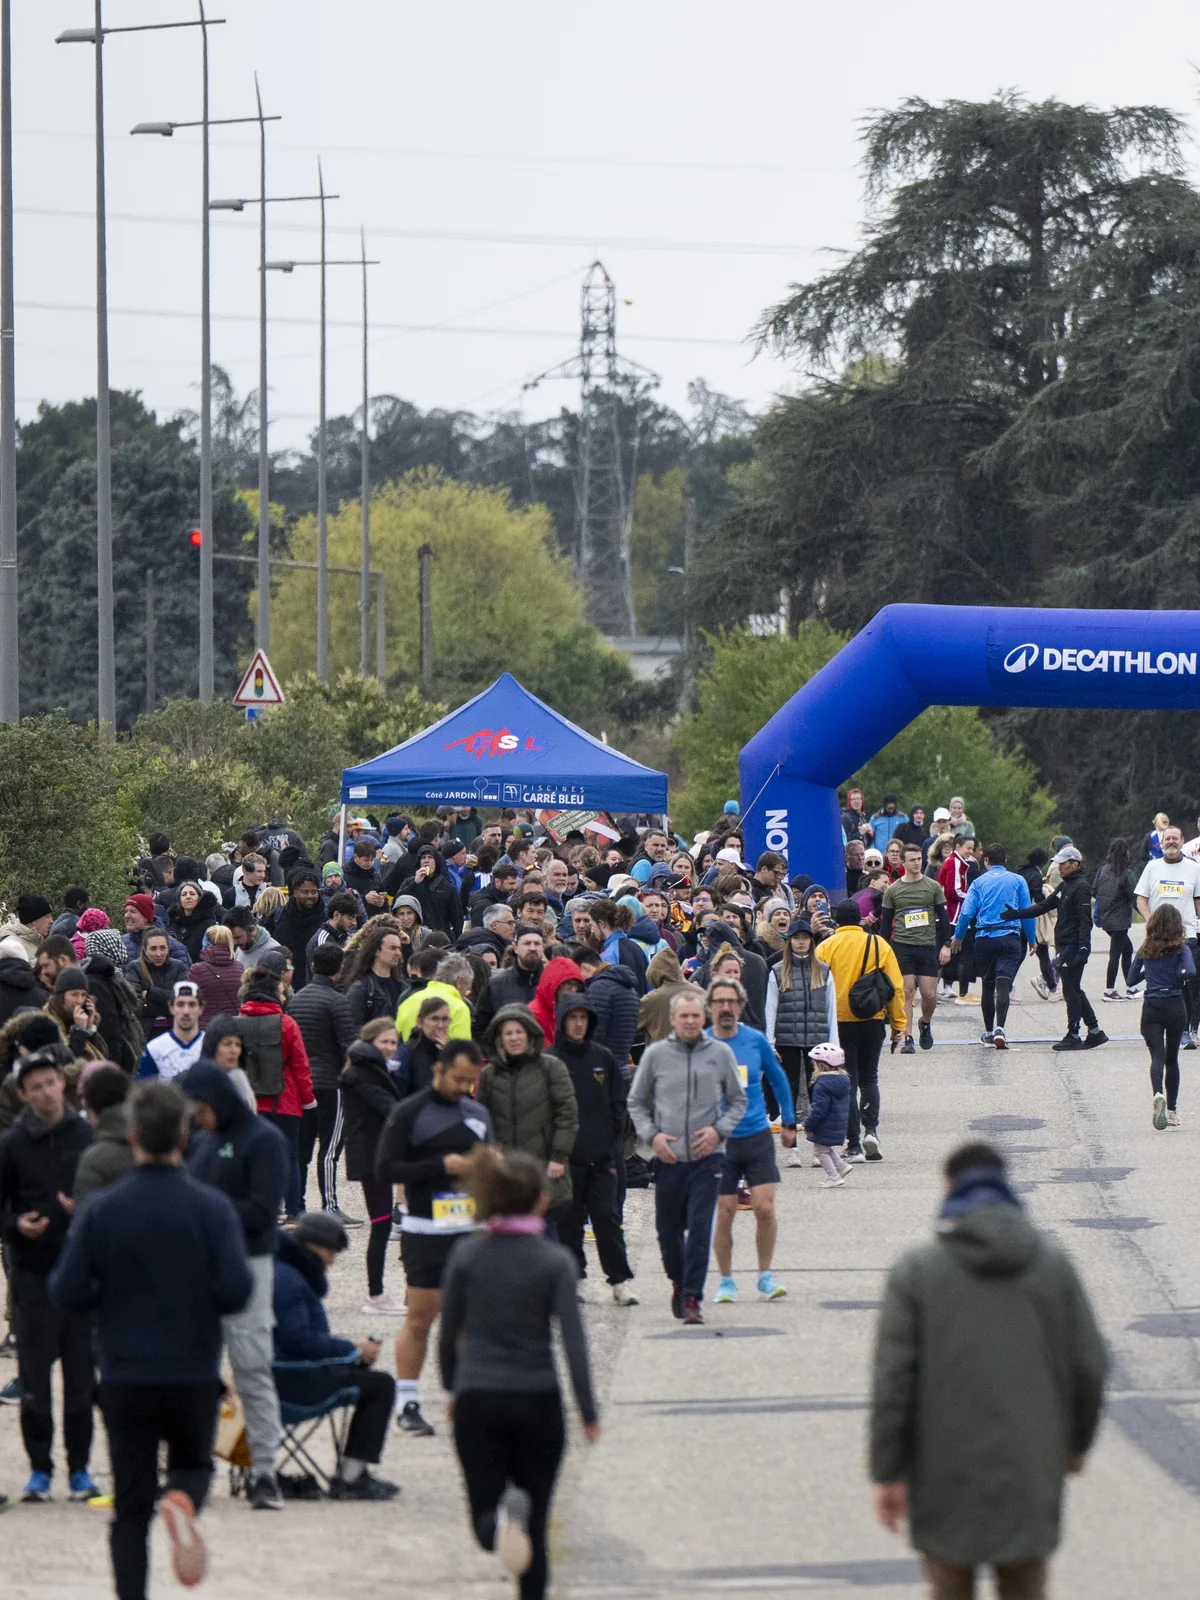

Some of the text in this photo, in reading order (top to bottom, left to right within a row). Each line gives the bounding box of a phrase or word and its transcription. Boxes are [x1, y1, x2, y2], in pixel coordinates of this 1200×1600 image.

[1043, 648, 1198, 675] DECATHLON
[523, 784, 585, 793] PISCINES
[425, 791, 477, 800] Côté JARDIN
[522, 791, 585, 805] CARRÉ BLEU
